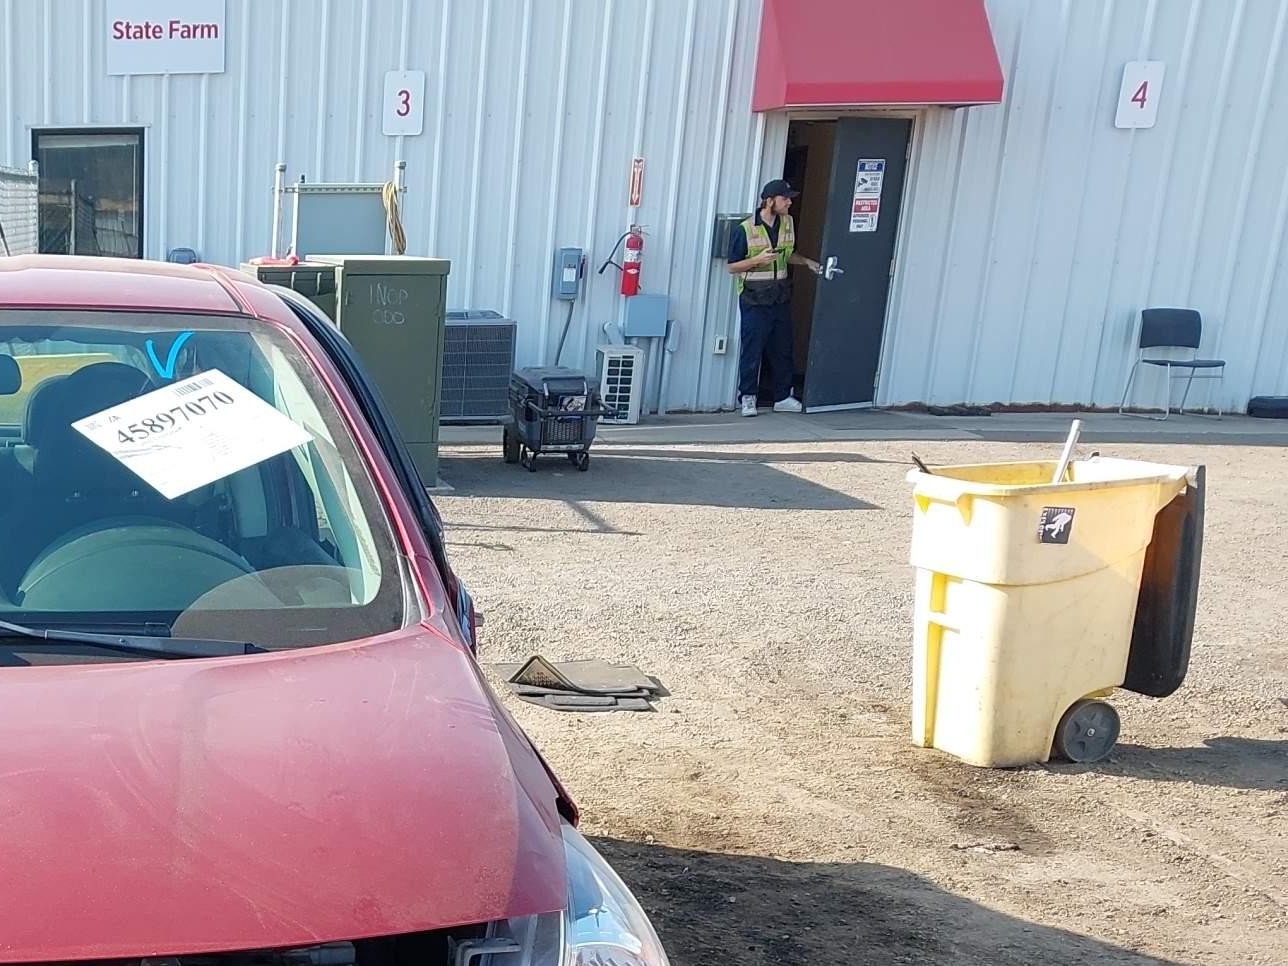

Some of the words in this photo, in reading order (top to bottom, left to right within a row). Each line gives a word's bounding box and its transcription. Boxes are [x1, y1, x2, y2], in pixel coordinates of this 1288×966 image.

[113, 21, 163, 39] State
[169, 21, 218, 39] Farm
[397, 90, 410, 116] 3
[1131, 81, 1148, 109] 4
[117, 391, 235, 444] 45897070
